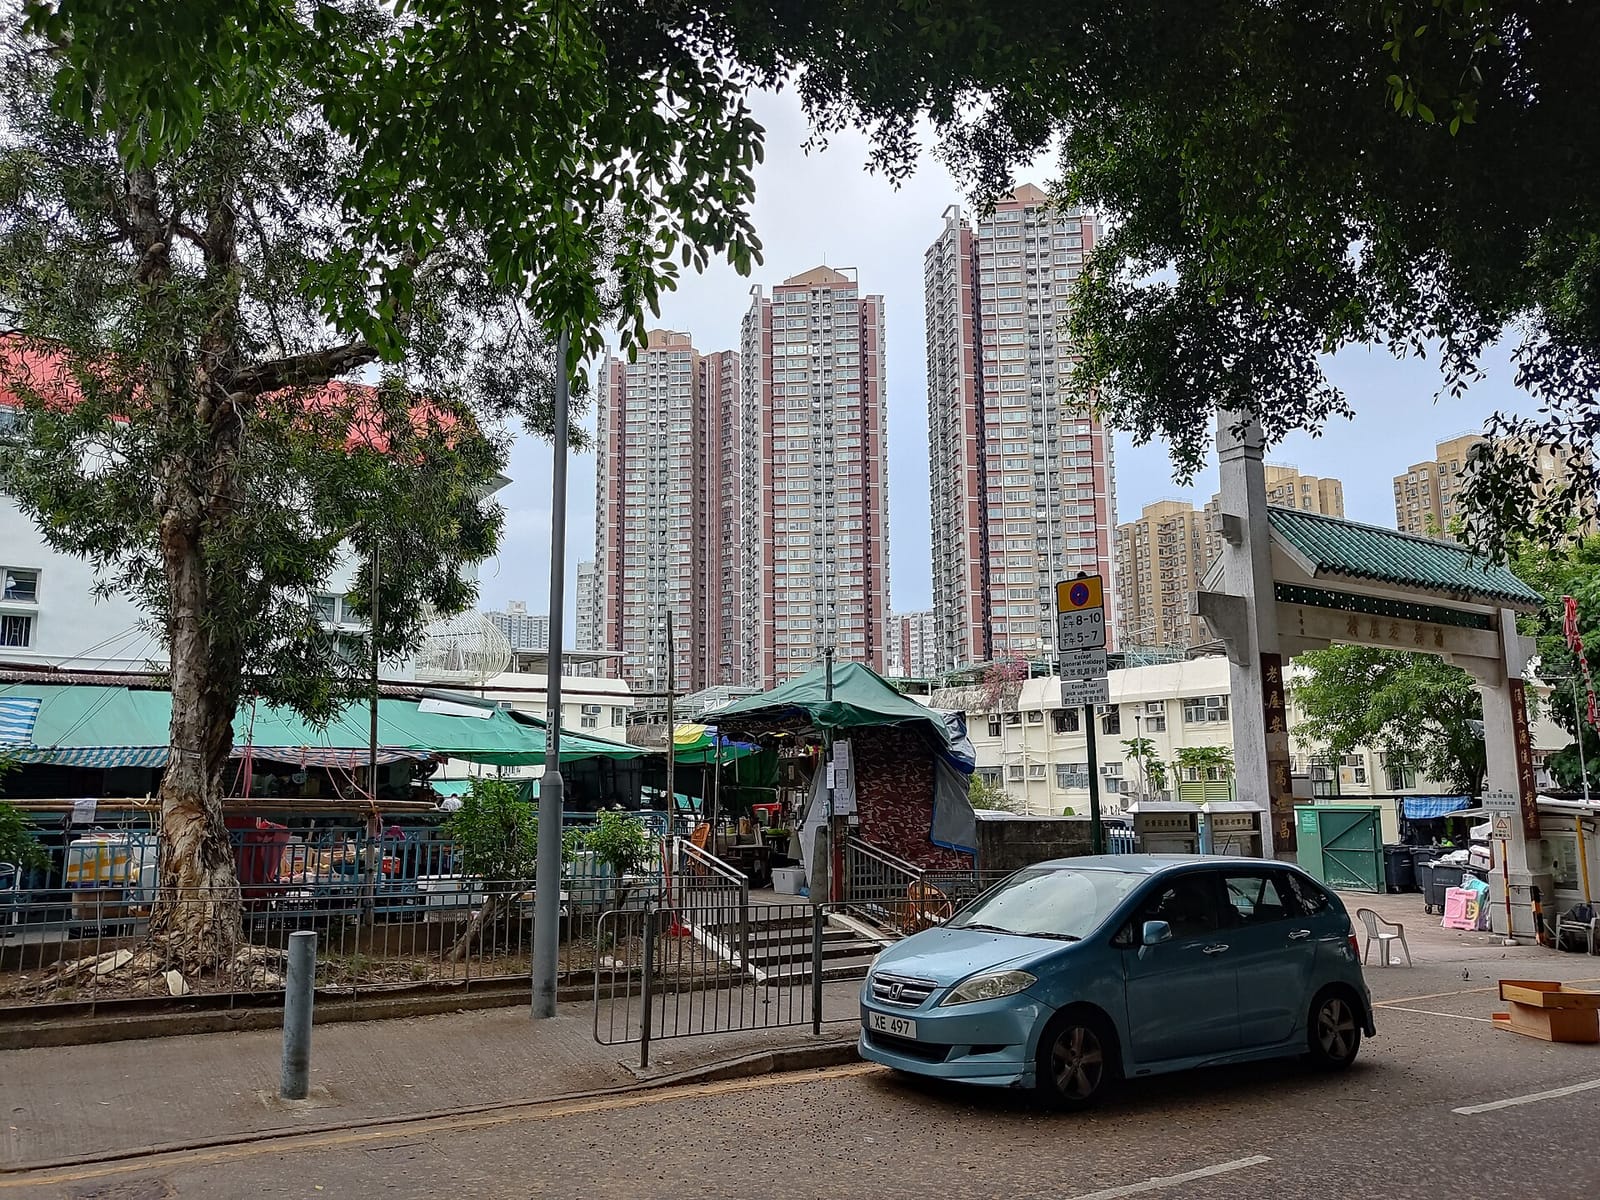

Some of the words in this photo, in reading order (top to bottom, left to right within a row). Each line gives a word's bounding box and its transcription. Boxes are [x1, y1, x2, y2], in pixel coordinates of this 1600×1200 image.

[1062, 621, 1075, 629] 上午
[1076, 612, 1101, 626] 8-10
[1062, 638, 1076, 647] 下午
[1077, 630, 1098, 643] 5-7
[874, 1015, 886, 1030] XE
[890, 1019, 910, 1035] 497
